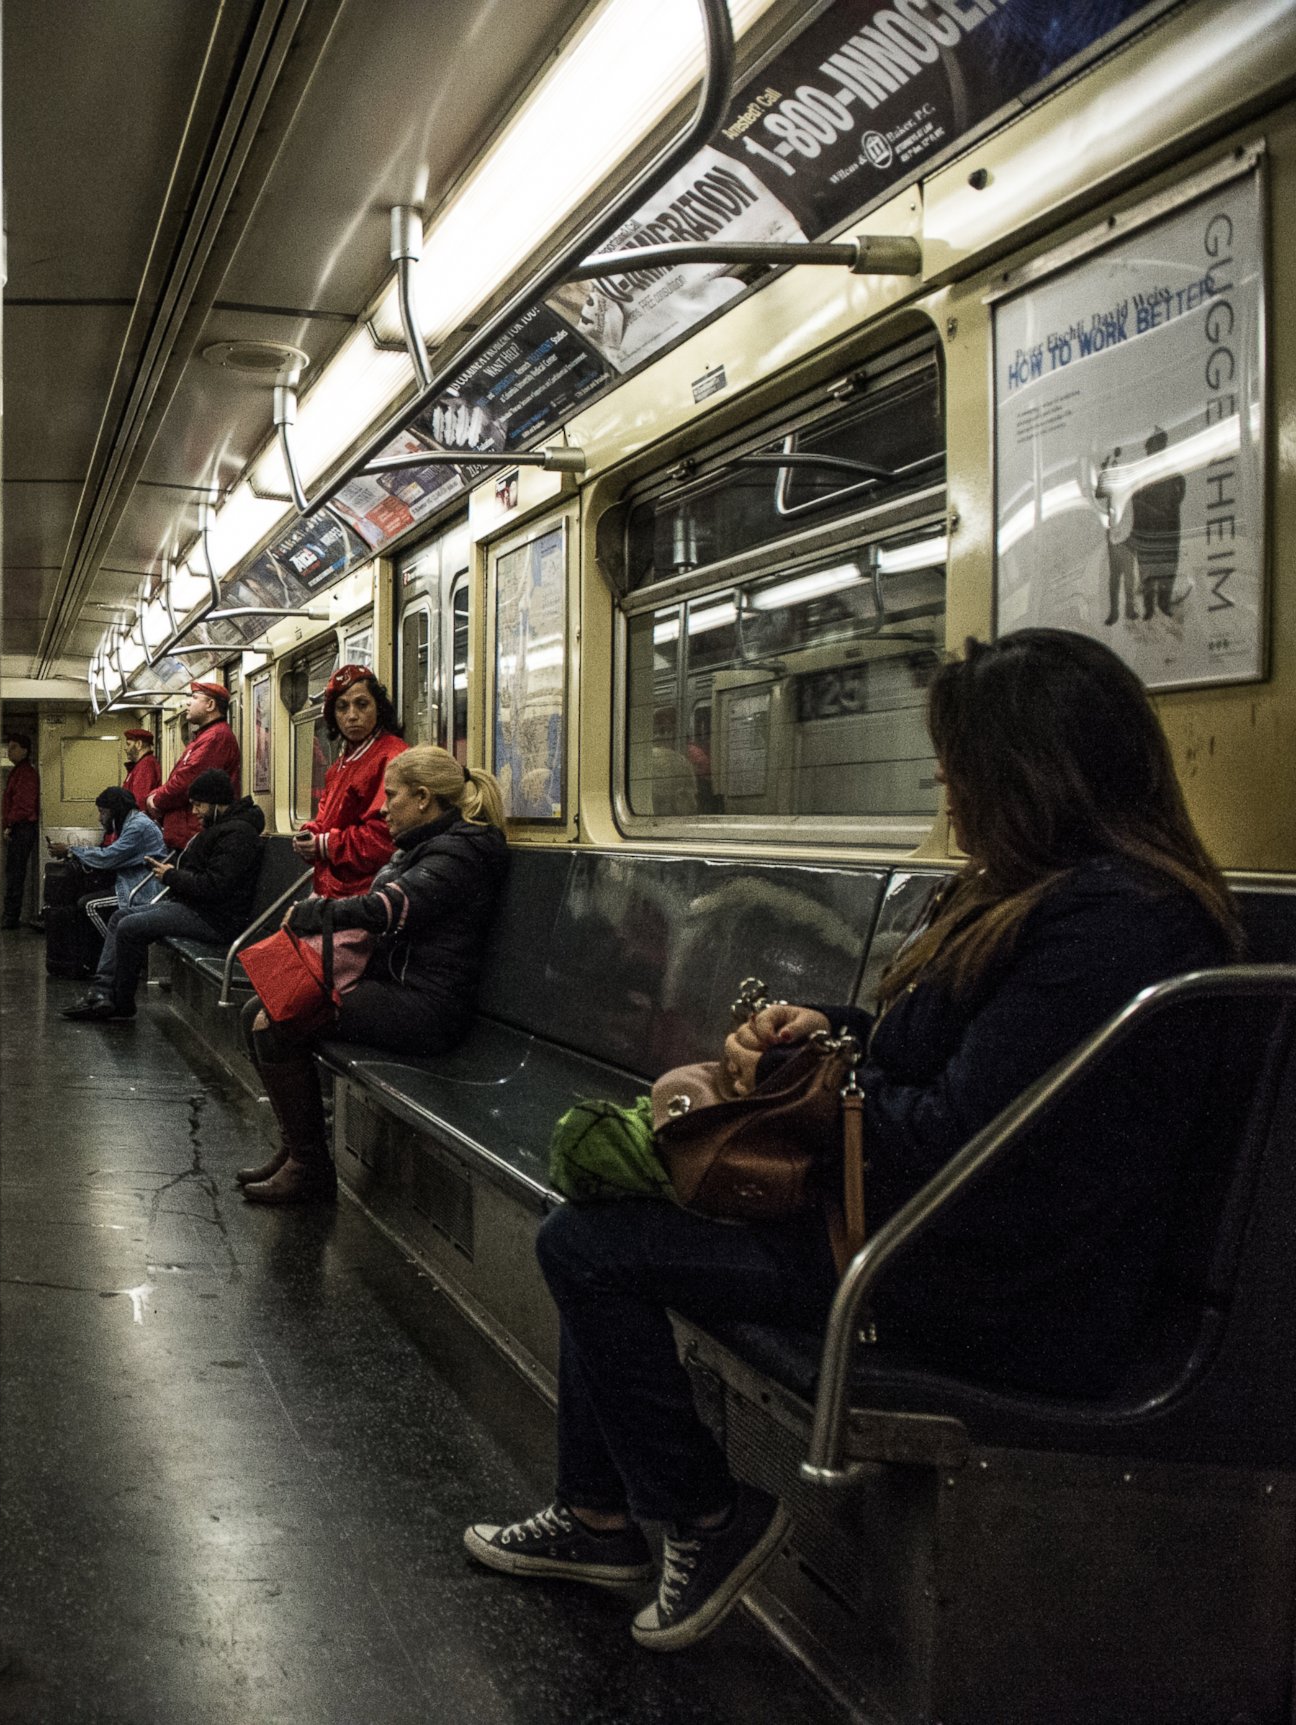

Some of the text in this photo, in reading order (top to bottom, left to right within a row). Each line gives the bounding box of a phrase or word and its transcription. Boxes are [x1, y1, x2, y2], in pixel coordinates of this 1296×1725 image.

[742, 0, 1006, 176] 1-800-INNOCE
[759, 87, 783, 111] Call
[912, 102, 936, 121] P.C.
[483, 342, 522, 377] WANT HELP?
[1008, 275, 1216, 390] HOW TO WORK BETTER
[1204, 213, 1235, 612] GUGGEHEIM
